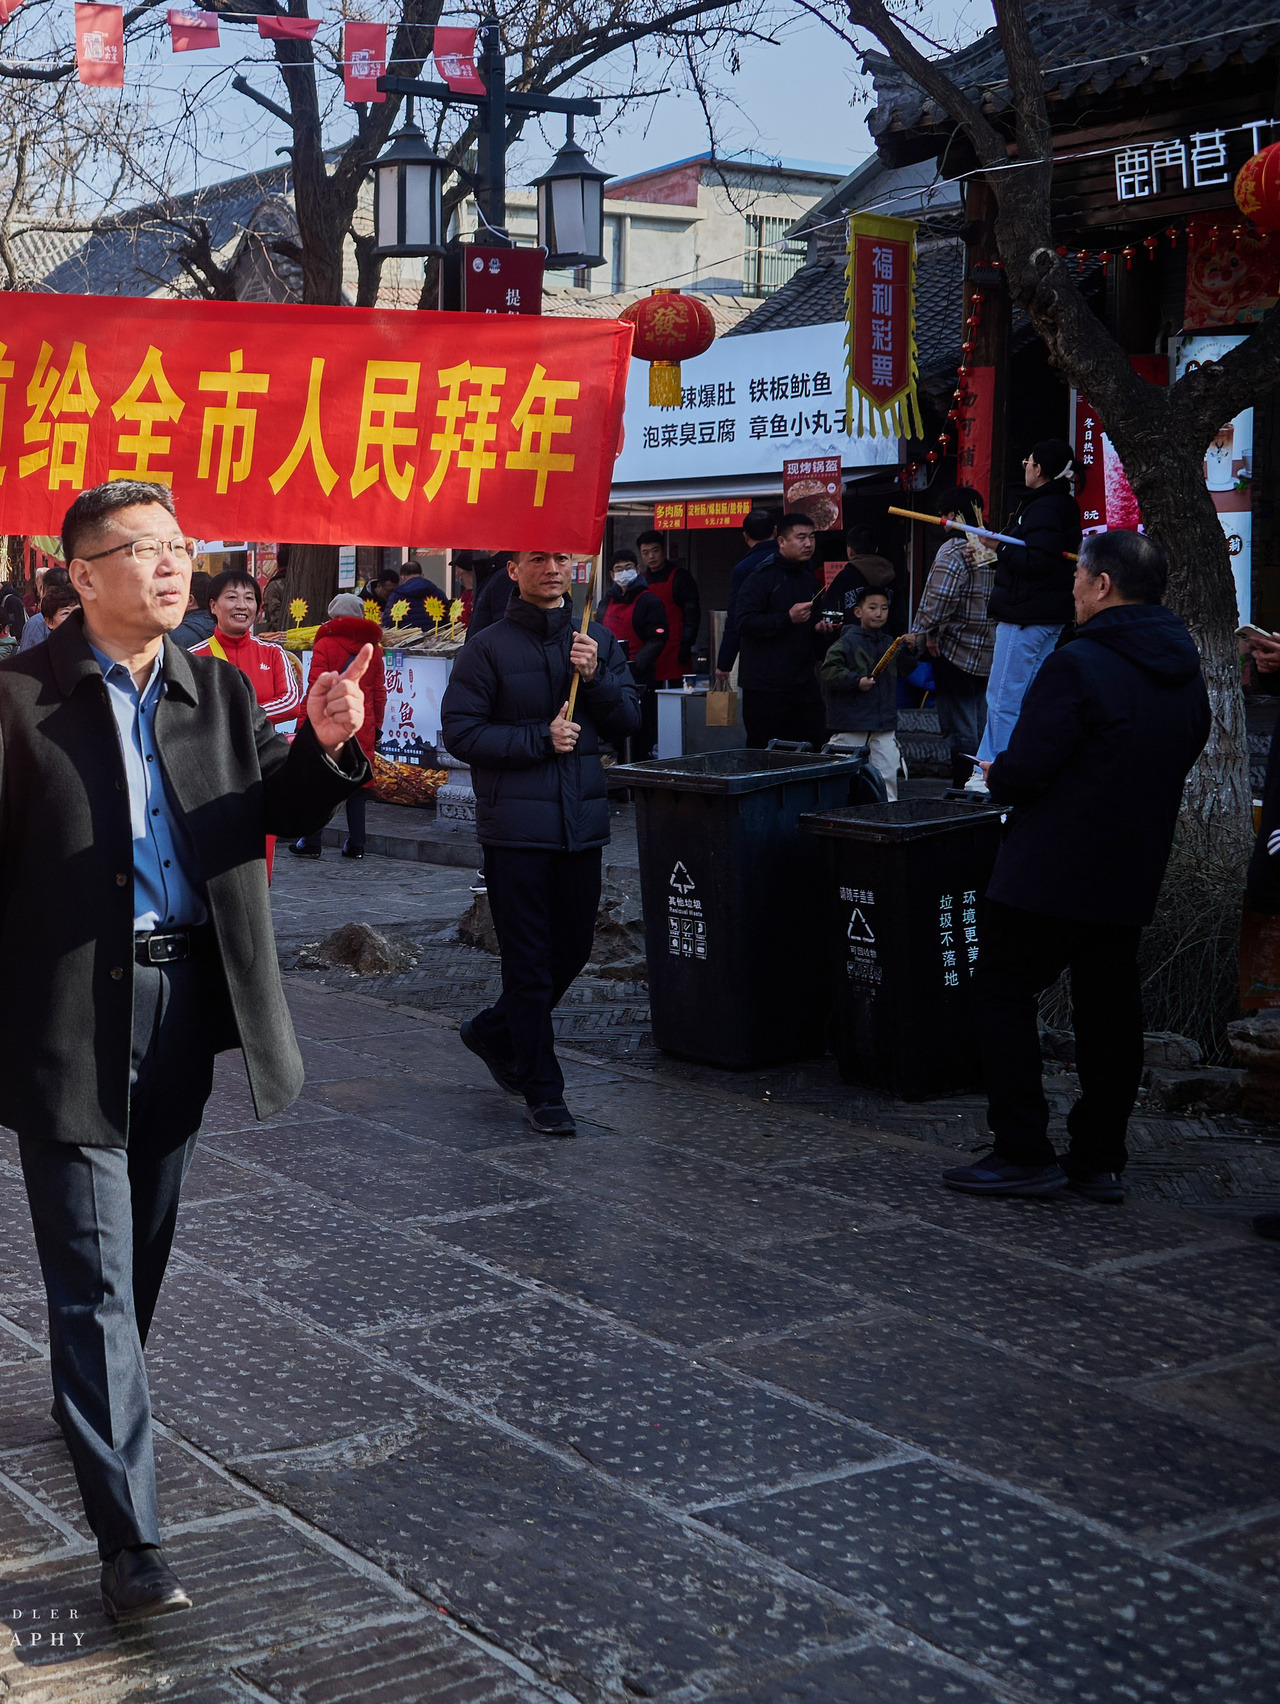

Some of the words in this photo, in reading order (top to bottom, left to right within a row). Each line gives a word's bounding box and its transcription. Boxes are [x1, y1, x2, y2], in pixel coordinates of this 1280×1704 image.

[1114, 128, 1229, 202] 鹿角巷
[505, 288, 521, 315] 提
[871, 245, 894, 388] 福利彩票
[650, 381, 736, 412] 辣爆肚
[749, 371, 833, 402] 铁板鱿鱼
[643, 418, 736, 449] 泡菜臭豆腐
[749, 409, 855, 441] 章鱼小丸子
[1083, 417, 1095, 465] 冬日热饮
[786, 459, 839, 475] 现烤锅盔
[656, 504, 684, 519] 多肉肠
[1083, 510, 1099, 520] 8元
[667, 895, 703, 910] 其他垃圾
[938, 893, 960, 987] 垃圾不落地
